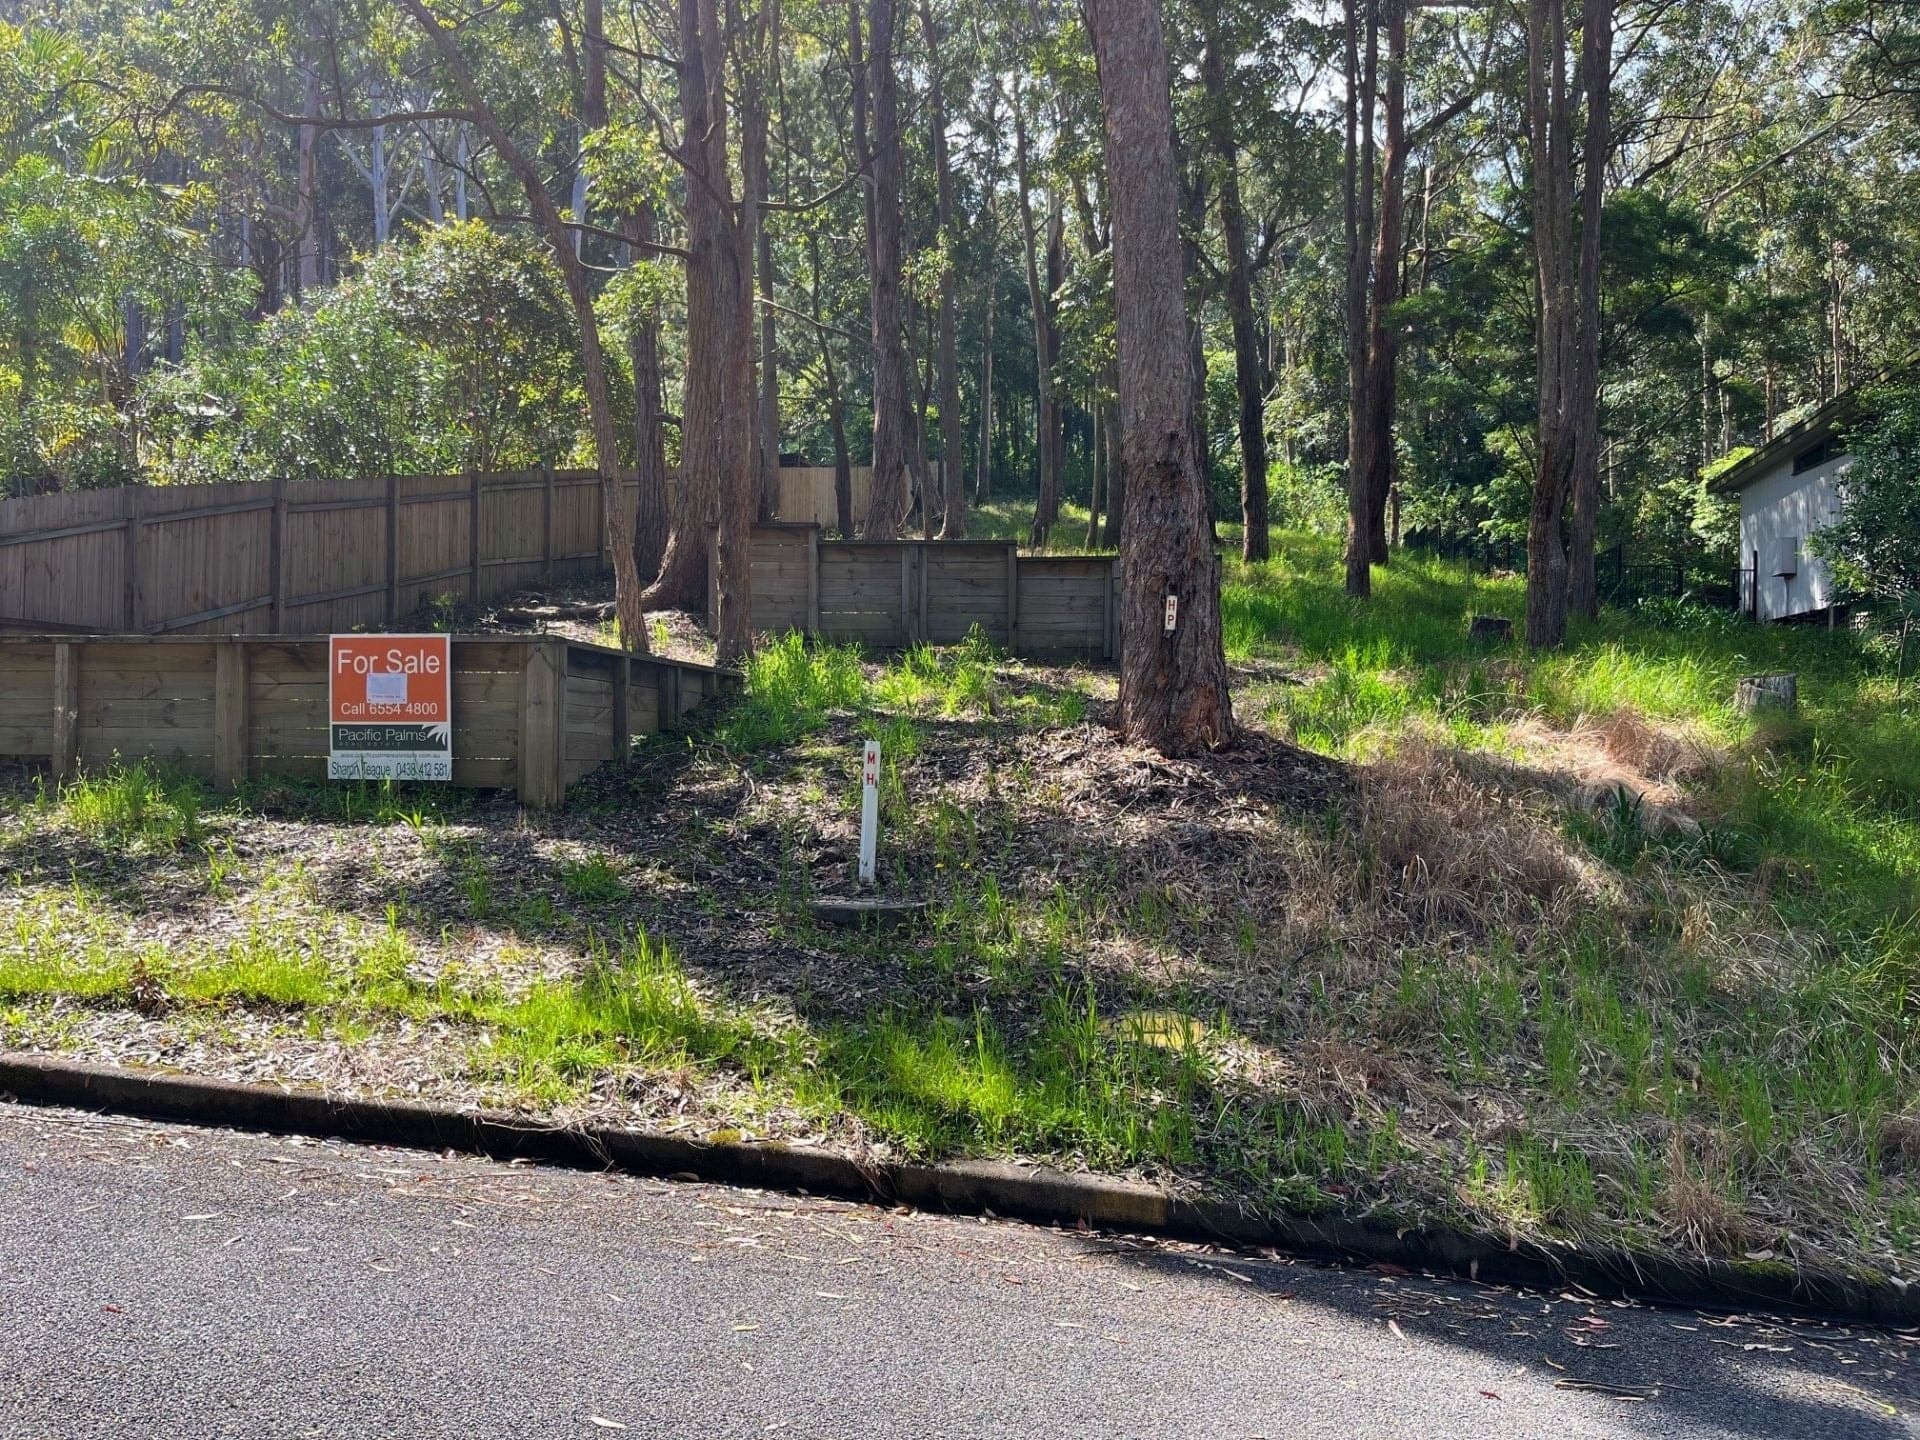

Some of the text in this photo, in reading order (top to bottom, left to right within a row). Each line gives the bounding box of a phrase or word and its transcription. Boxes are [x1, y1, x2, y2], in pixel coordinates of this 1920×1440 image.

[1167, 599, 1176, 626] HP
[337, 648, 441, 674] For Sale
[340, 702, 438, 715] Call 6554 4800
[338, 728, 427, 742] Pacific Palms
[361, 761, 391, 778] Teague
[866, 750, 876, 785] MH
